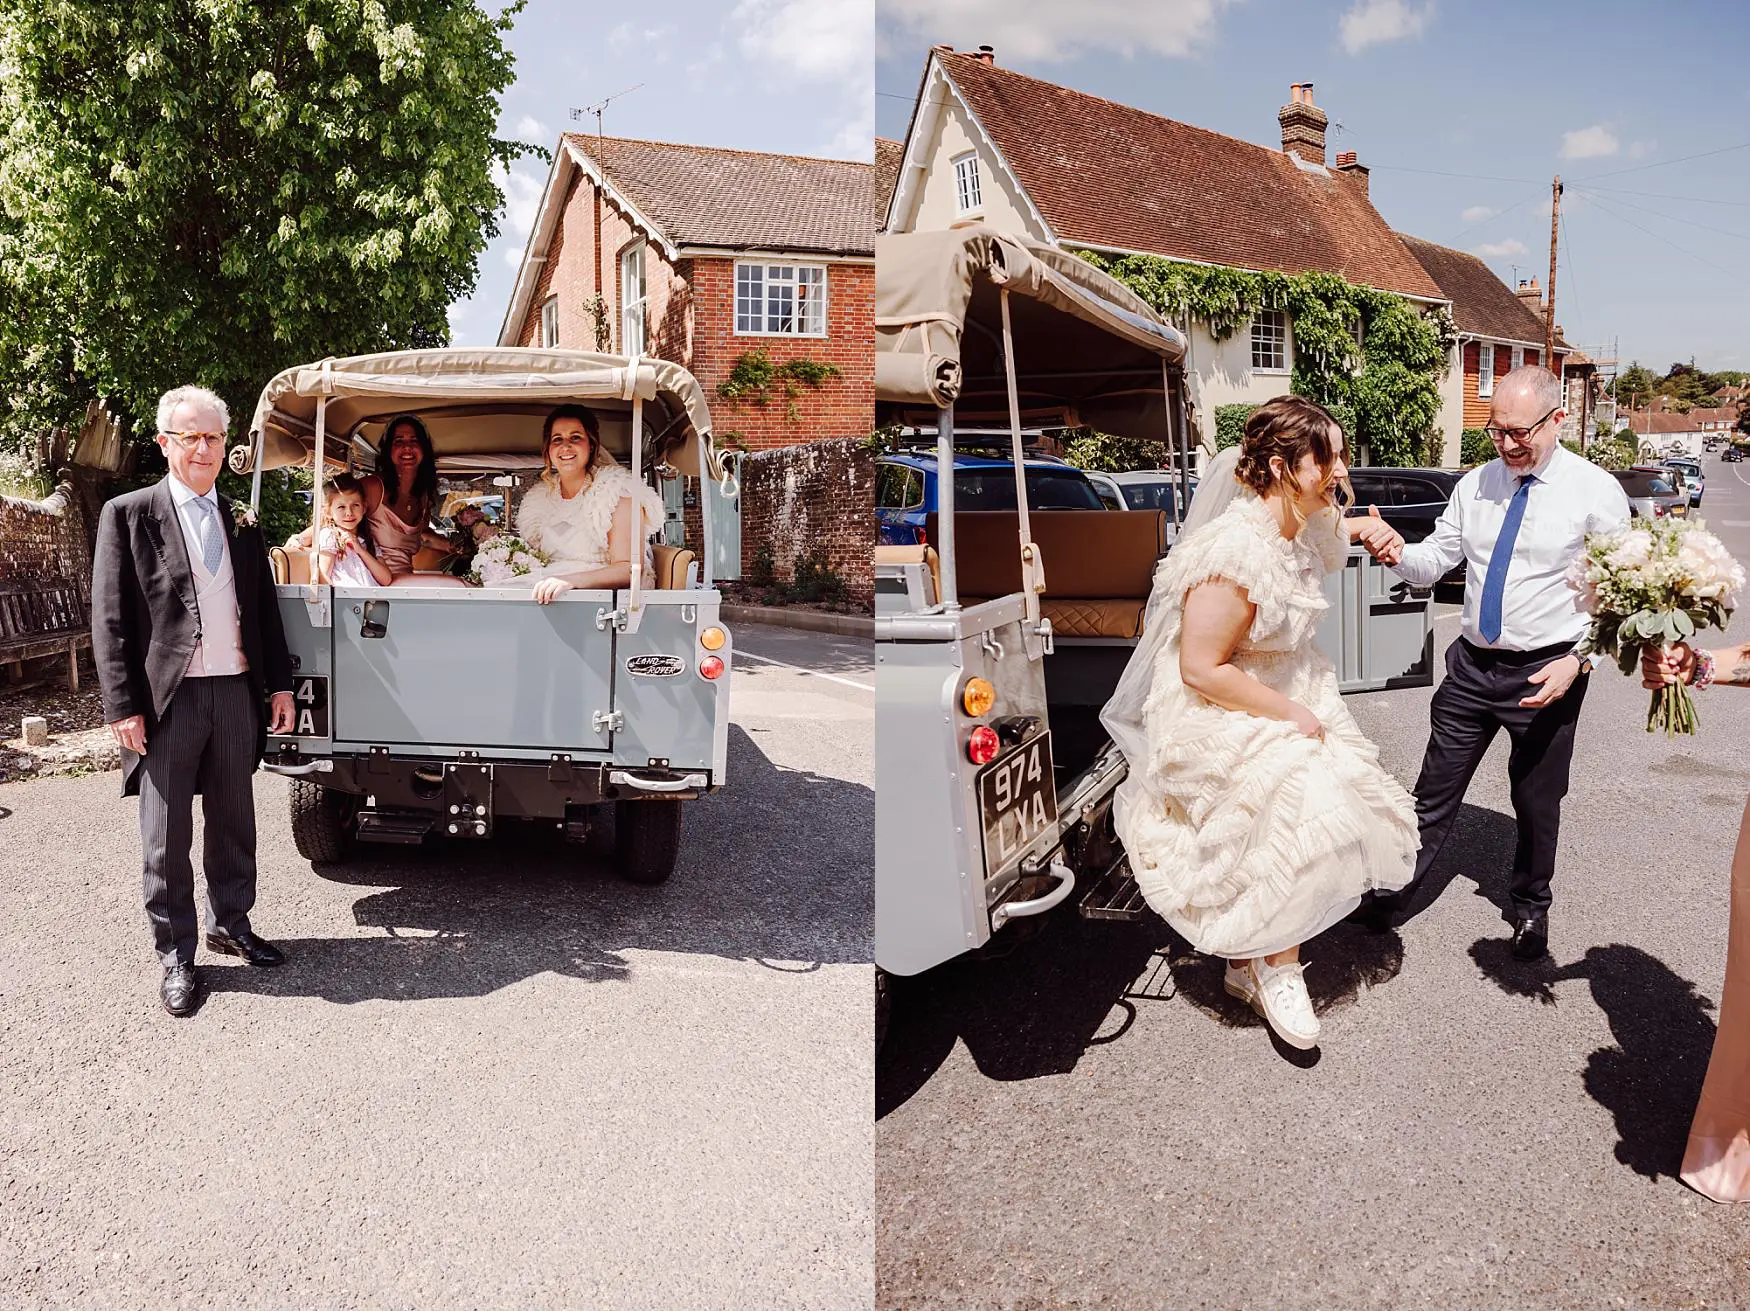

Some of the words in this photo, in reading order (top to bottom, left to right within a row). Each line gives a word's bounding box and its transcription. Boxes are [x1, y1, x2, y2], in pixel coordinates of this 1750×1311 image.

[635, 657, 660, 666] LAND
[647, 666, 676, 674] ROVER
[995, 743, 1042, 812] 974
[998, 790, 1048, 861] LYA
